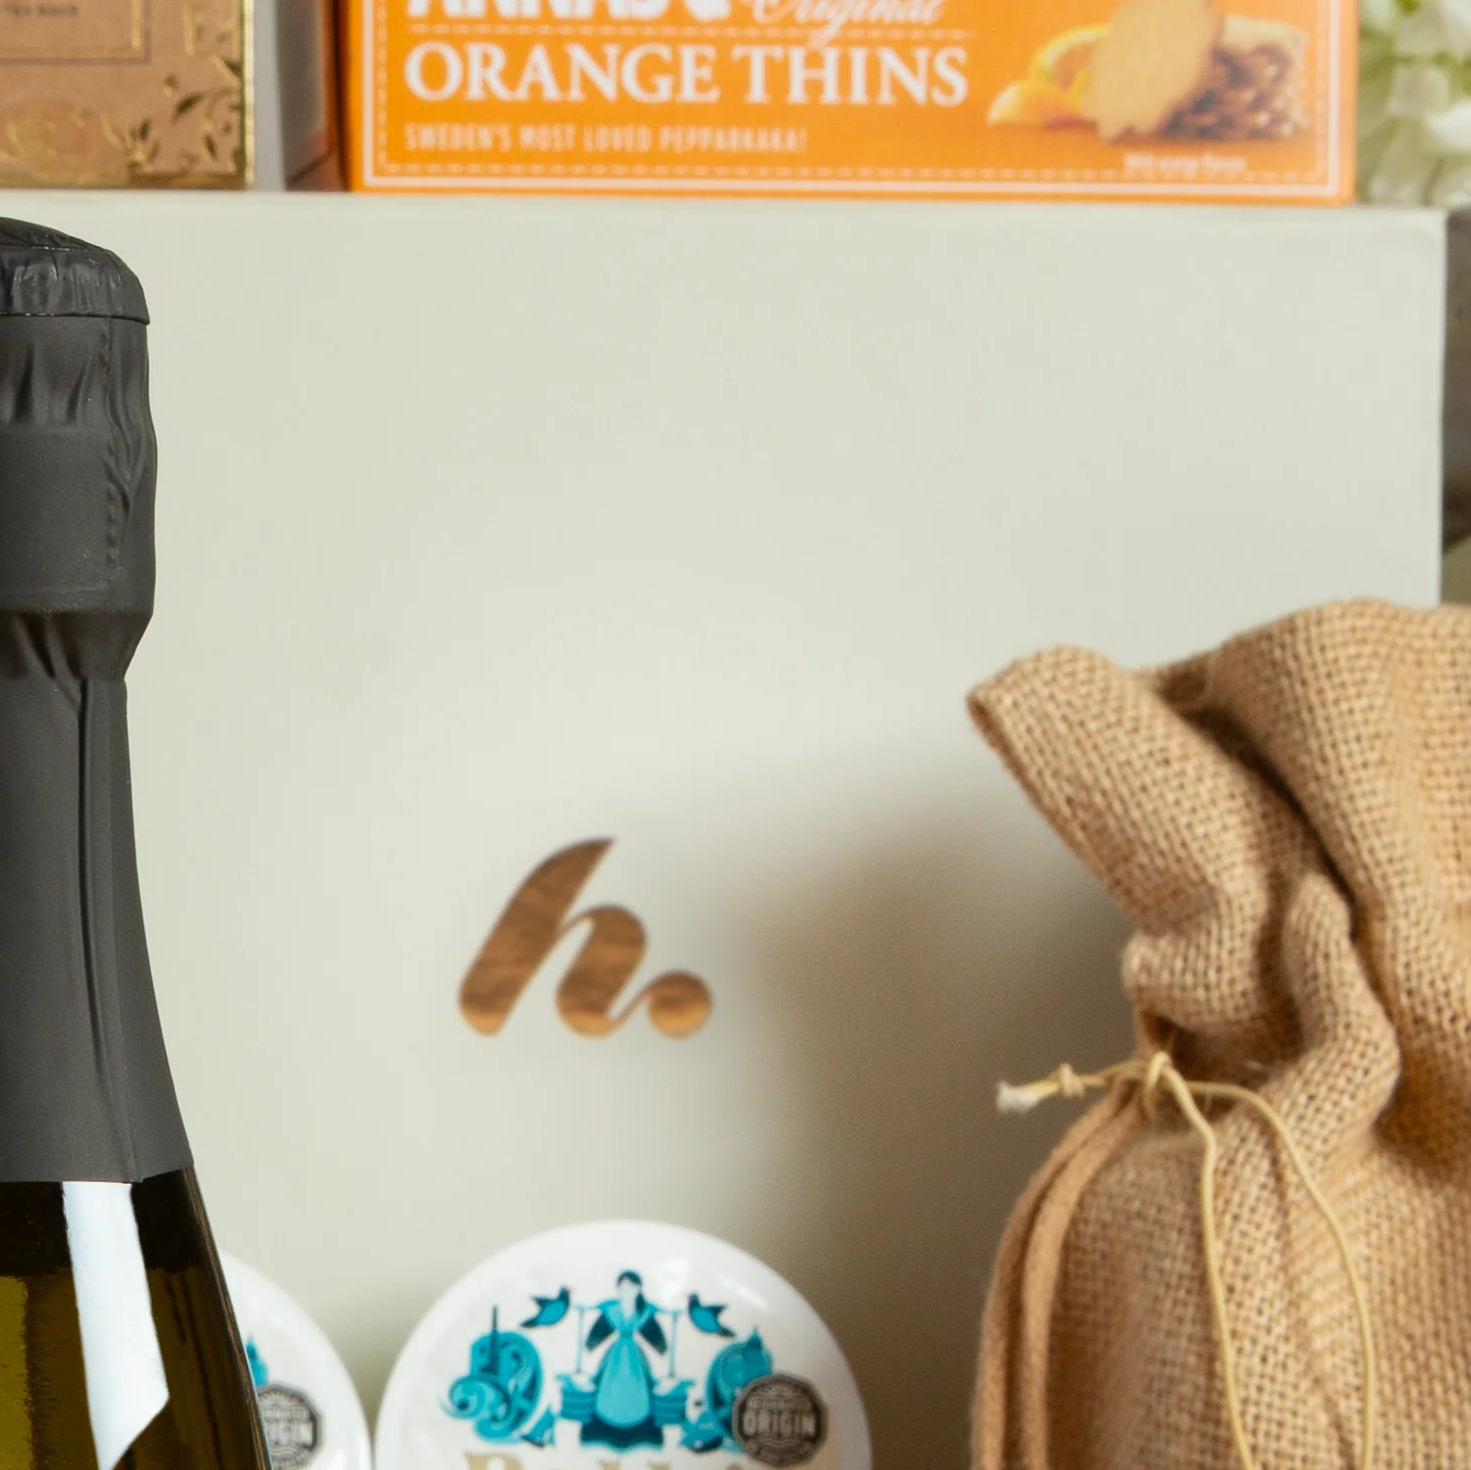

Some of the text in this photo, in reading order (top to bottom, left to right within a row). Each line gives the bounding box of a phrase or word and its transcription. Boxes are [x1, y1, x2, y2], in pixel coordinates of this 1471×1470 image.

[404, 41, 969, 107] ORANGE THINS
[403, 122, 512, 152] SWEDEN'S
[520, 124, 576, 151] MOST
[584, 124, 651, 152] LOVED
[743, 1410, 816, 1436] ORIGIN
